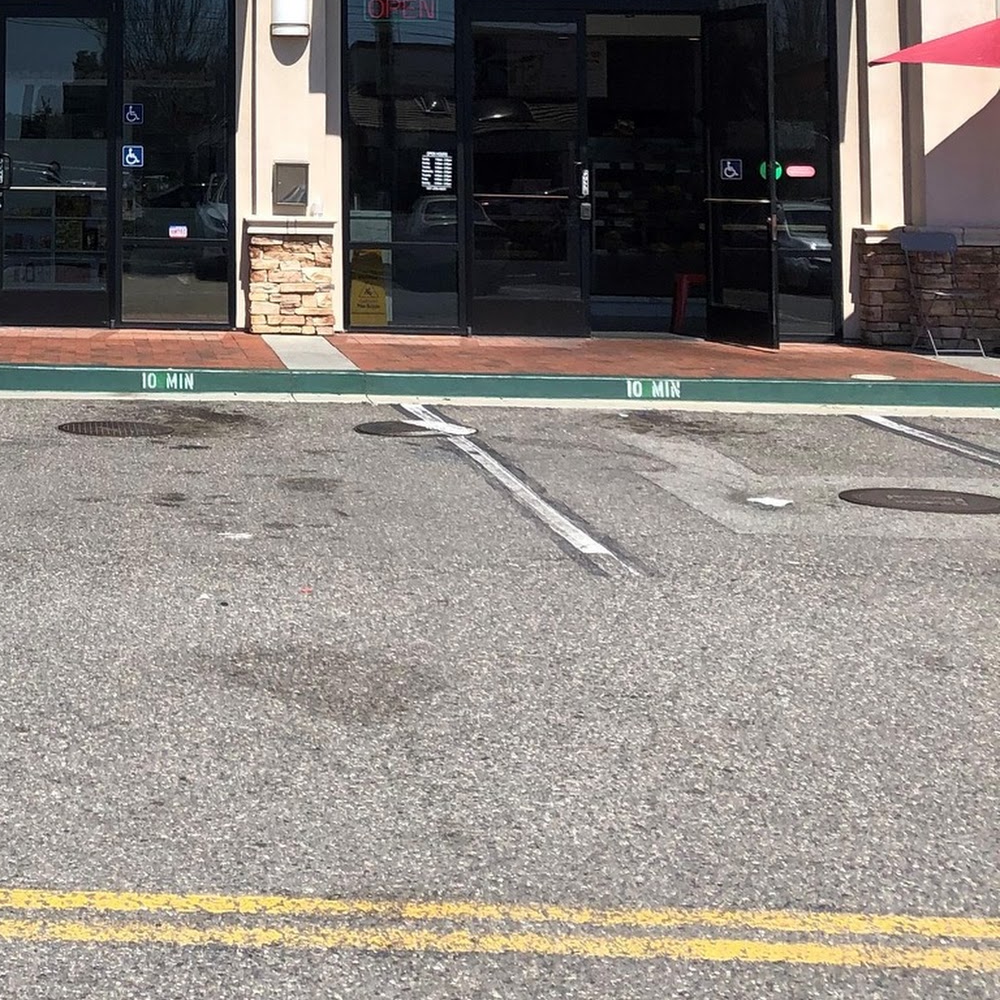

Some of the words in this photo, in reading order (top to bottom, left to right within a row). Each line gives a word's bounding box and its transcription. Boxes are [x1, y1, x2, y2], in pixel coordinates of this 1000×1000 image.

[141, 371, 157, 389] 10
[166, 372, 194, 390] MIN
[626, 379, 643, 398] 10
[651, 380, 681, 399] MIN
